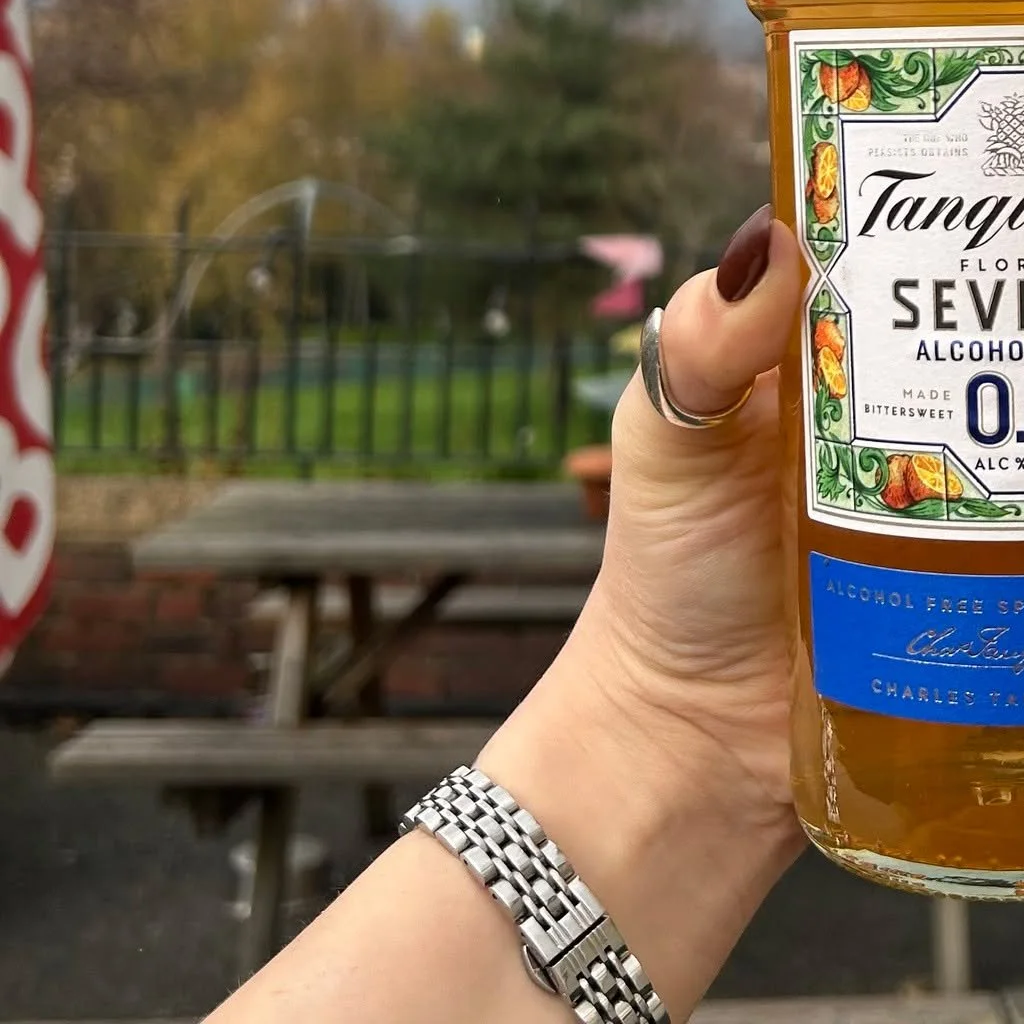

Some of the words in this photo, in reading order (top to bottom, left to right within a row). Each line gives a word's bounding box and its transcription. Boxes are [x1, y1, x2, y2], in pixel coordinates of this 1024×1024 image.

[920, 147, 969, 157] OBTAINS
[903, 388, 952, 401] MADE
[864, 403, 954, 420] BITTERSWEET
[974, 456, 1010, 471] ALC
[826, 579, 914, 609] ALCOHOL
[926, 597, 984, 615] FREE
[871, 678, 975, 707] CHARLES
